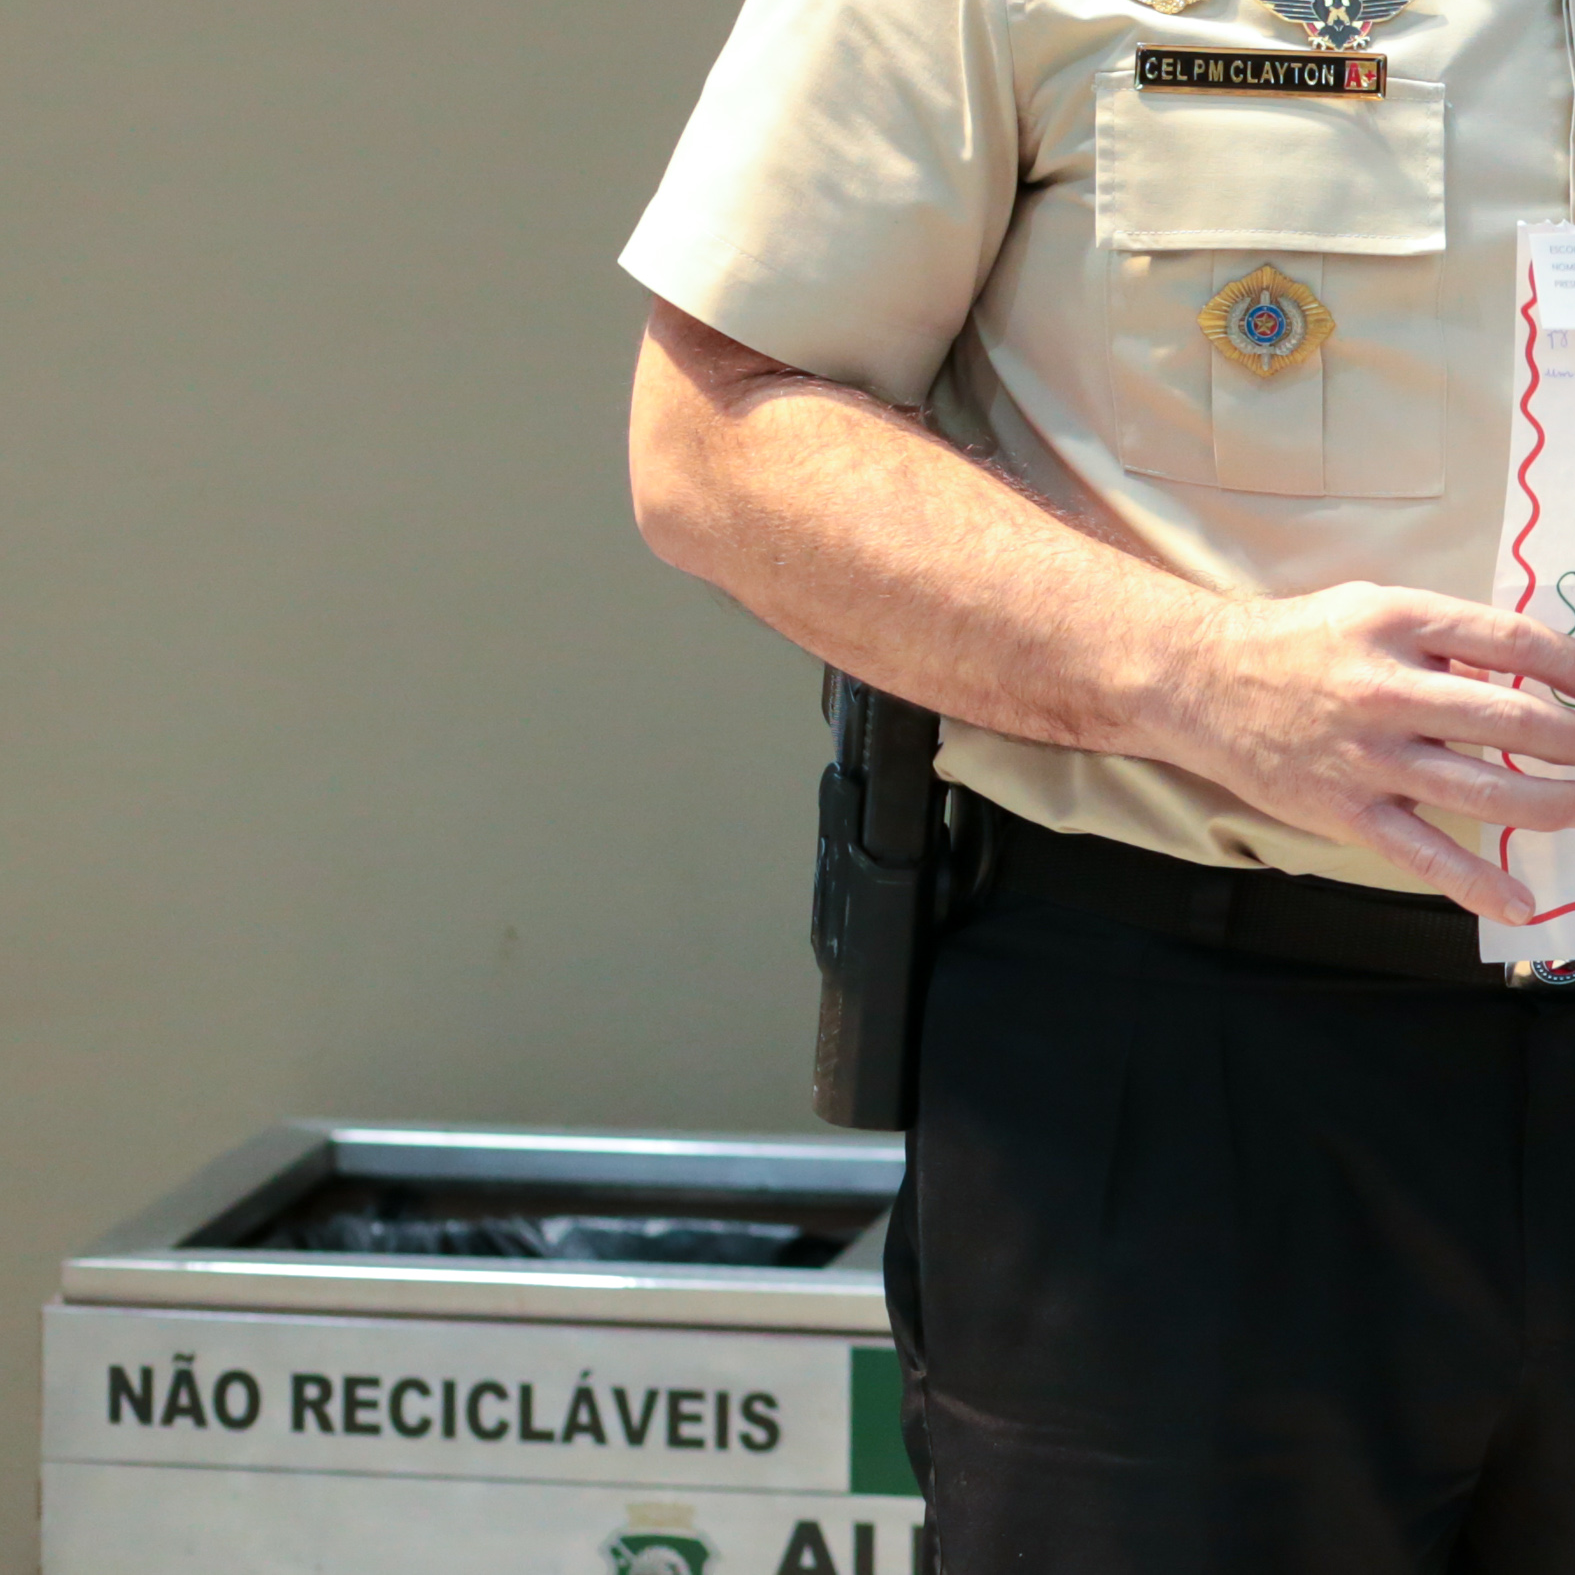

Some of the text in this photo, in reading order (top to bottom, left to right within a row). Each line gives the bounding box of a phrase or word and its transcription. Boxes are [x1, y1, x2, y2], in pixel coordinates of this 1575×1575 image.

[1144, 57, 1188, 82] CEL
[1193, 60, 1224, 83] PM
[1229, 61, 1335, 87] CLAYTON
[107, 1353, 784, 1453] NÃO RECICLÁVEIS
